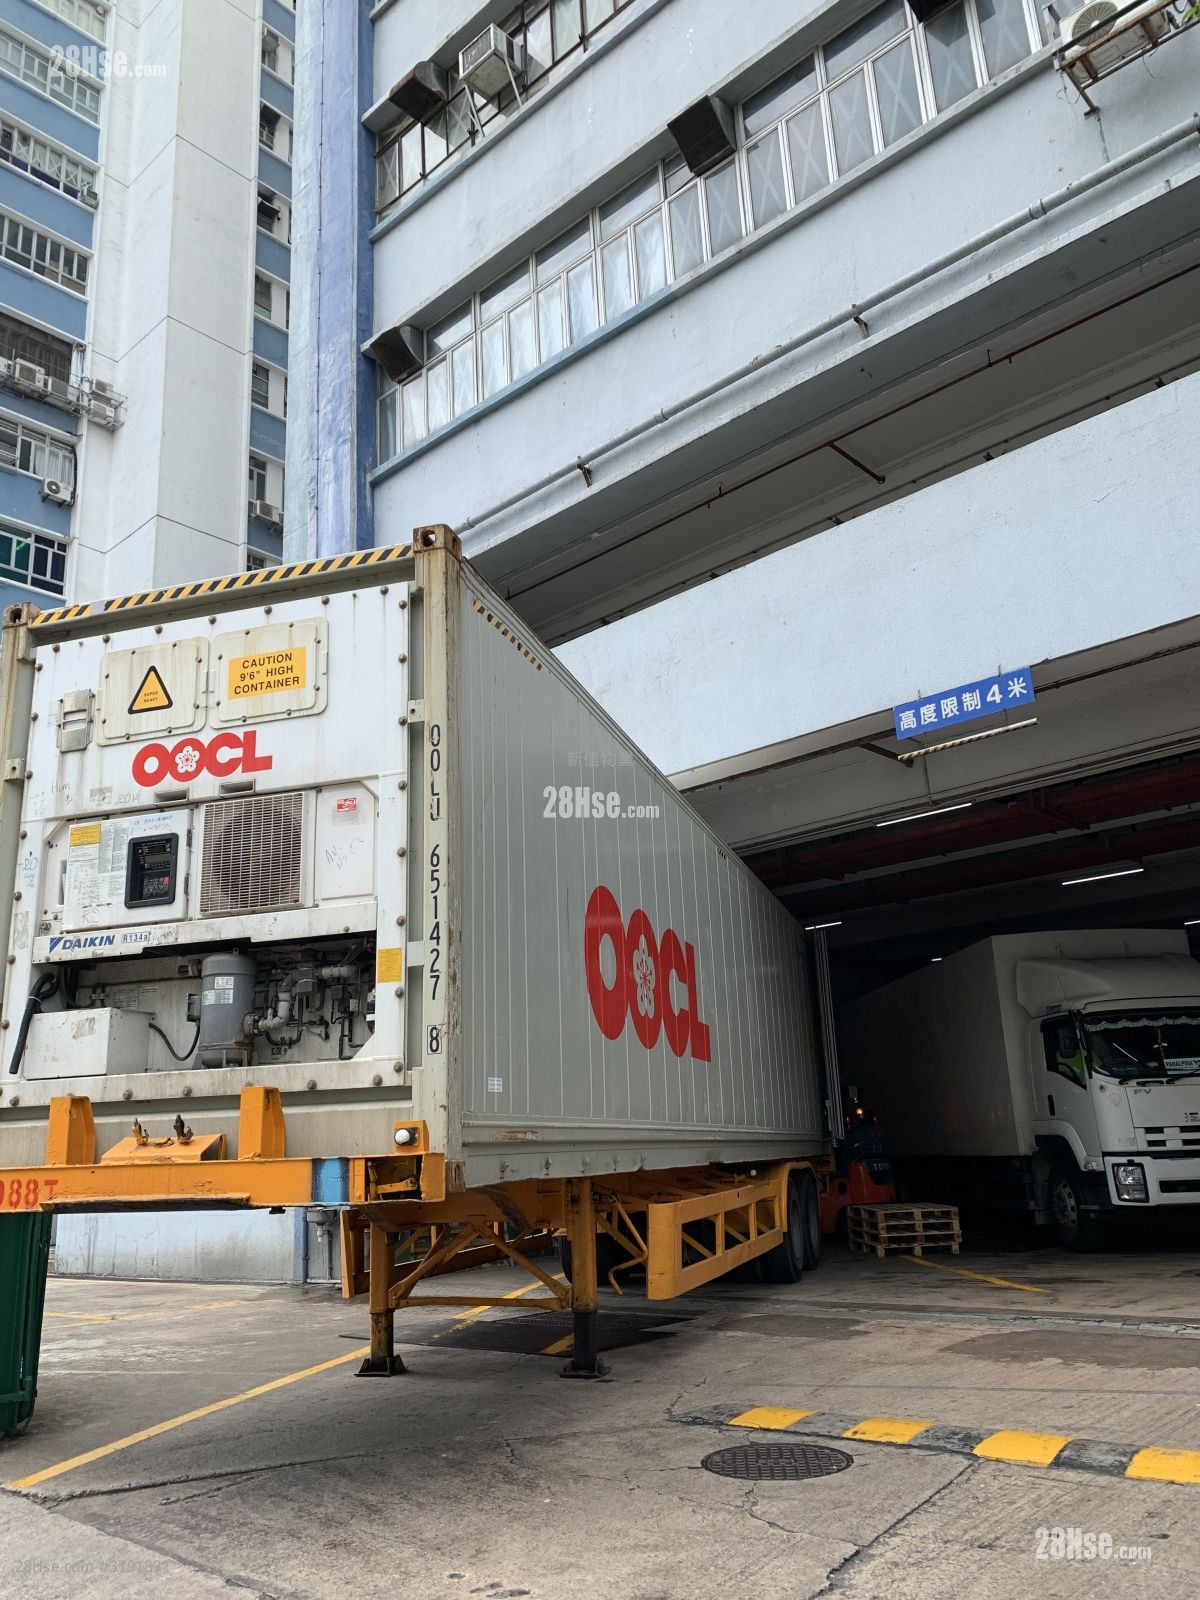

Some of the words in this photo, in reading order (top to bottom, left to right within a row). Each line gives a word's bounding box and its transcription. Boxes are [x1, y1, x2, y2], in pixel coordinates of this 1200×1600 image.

[242, 652, 293, 669] CAUTION
[266, 665, 294, 677] HIGH
[234, 676, 300, 695] CONTAINER
[898, 677, 1028, 731] 高度限制4米
[132, 730, 273, 787] OOCL
[429, 844, 441, 1000] 651427
[61, 935, 116, 950] DAIKIN
[584, 885, 712, 1063] OOCL
[429, 1026, 440, 1053] 8
